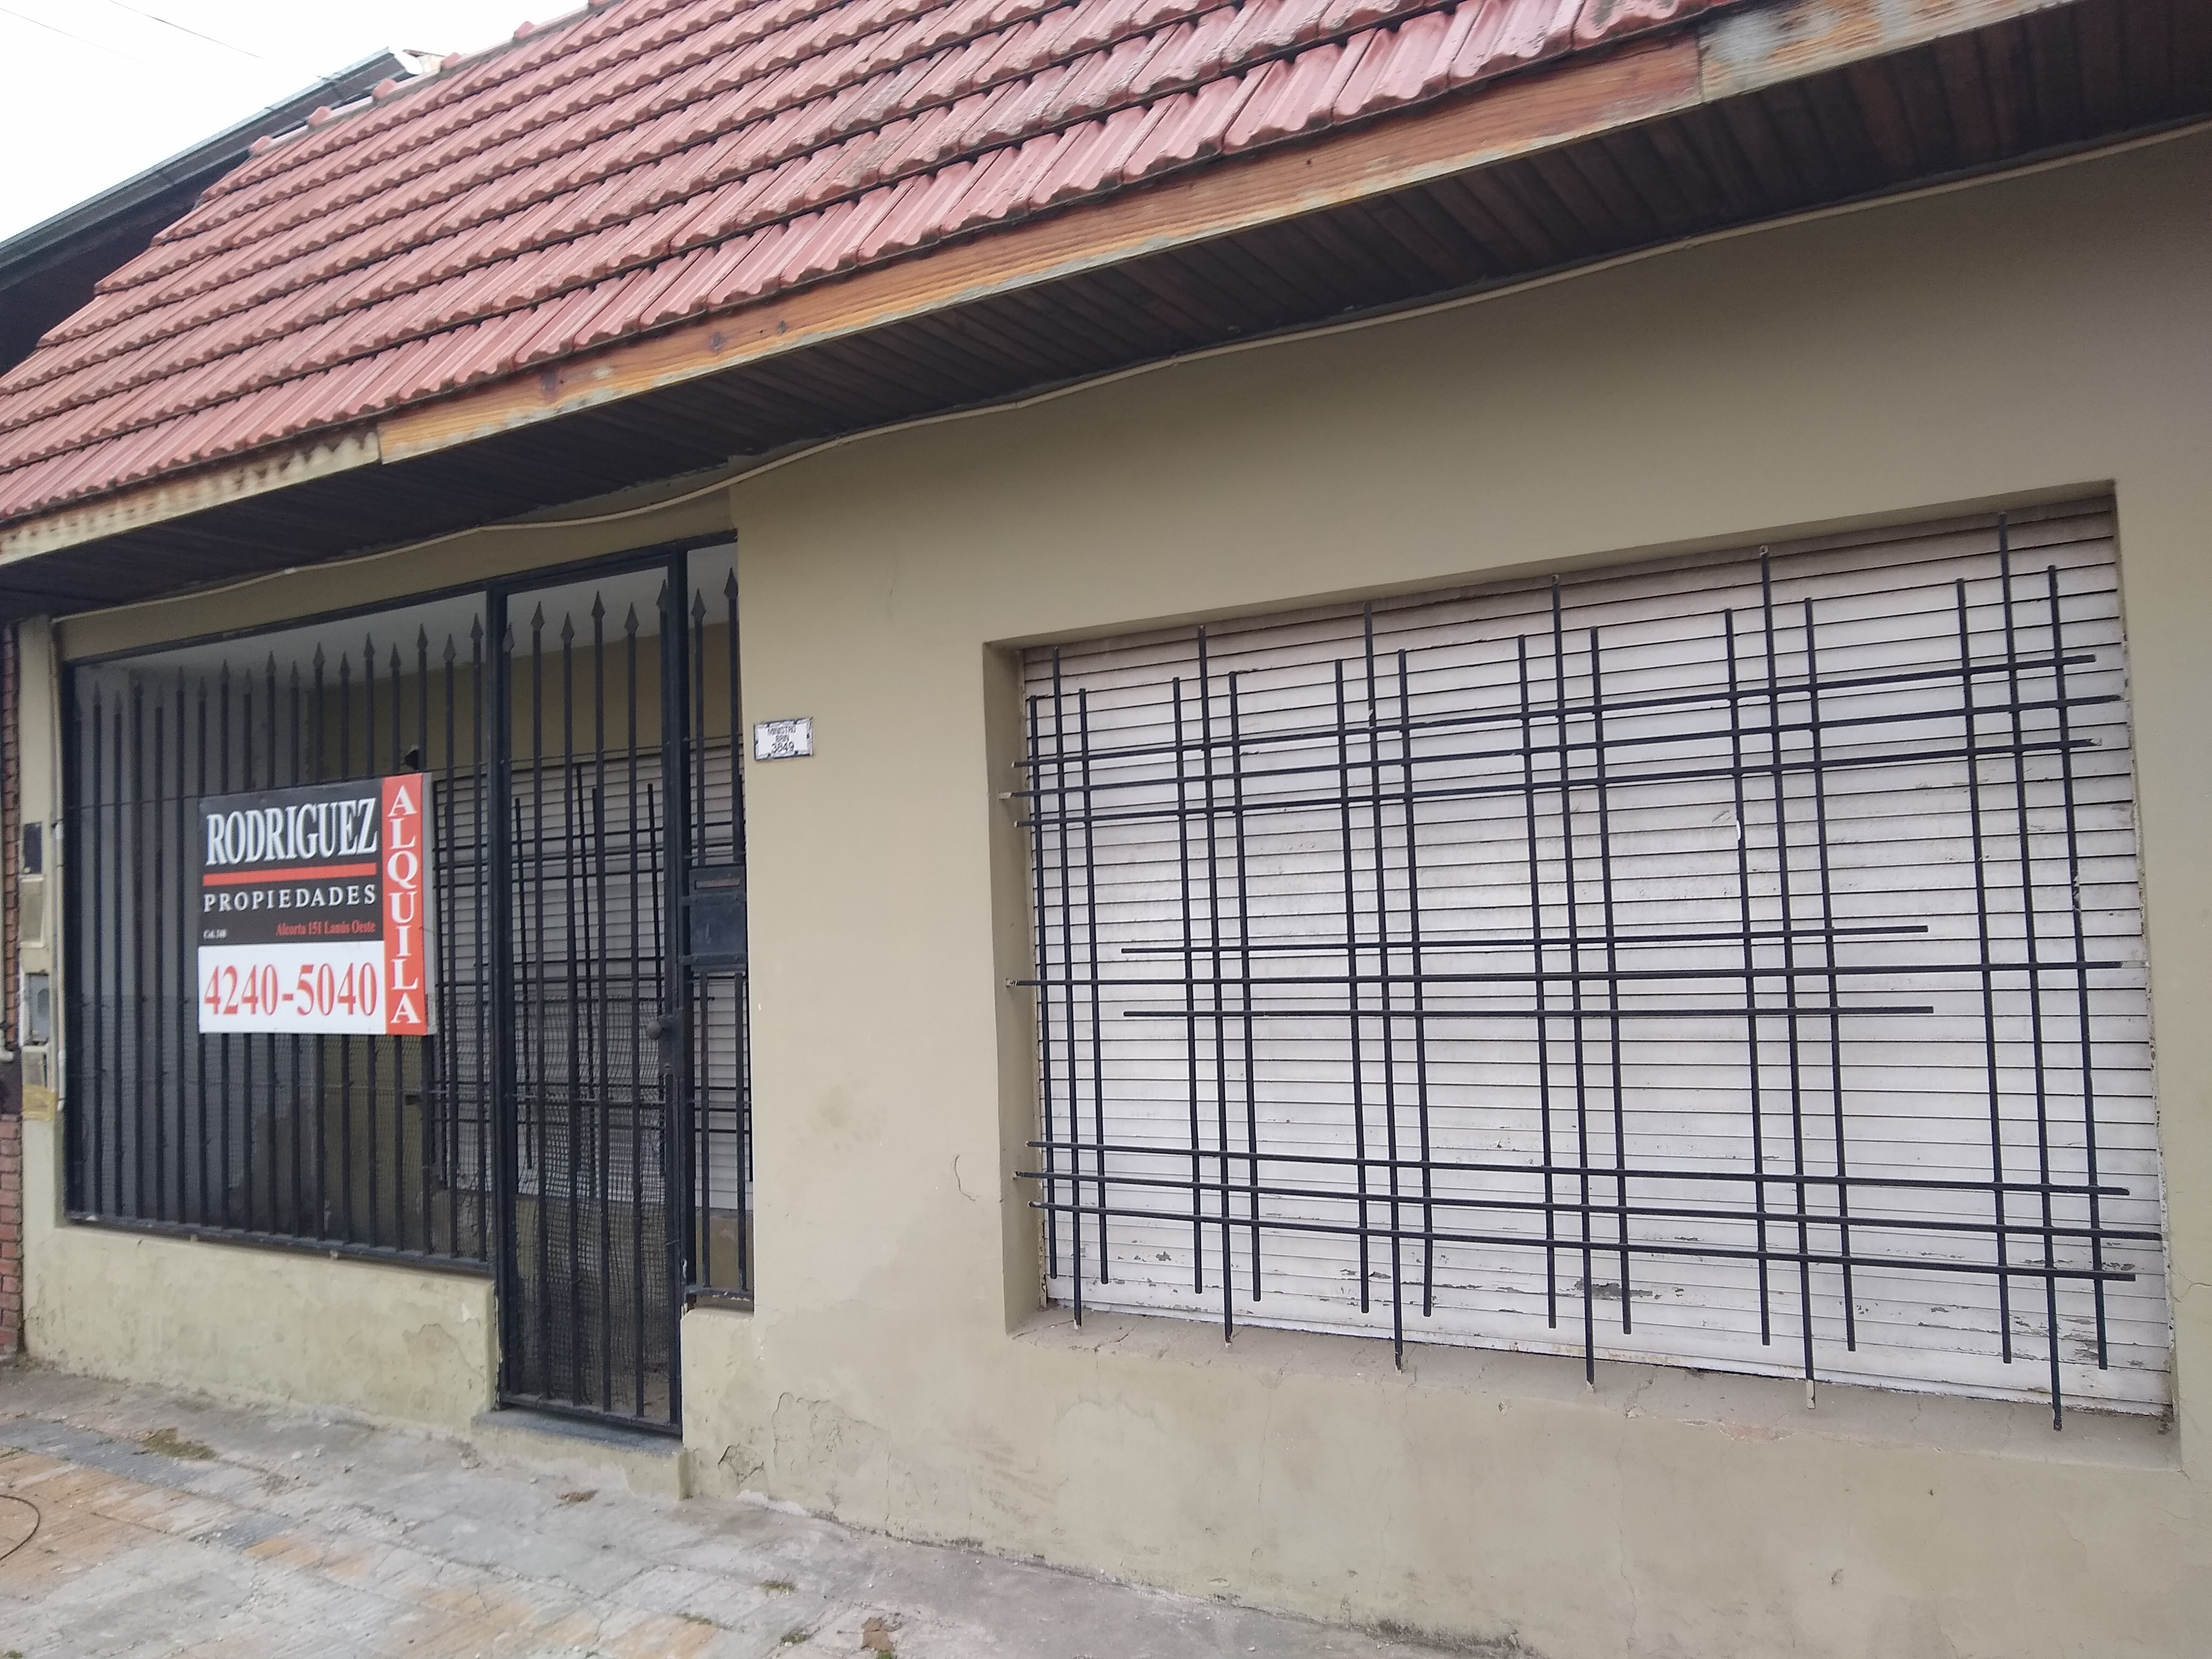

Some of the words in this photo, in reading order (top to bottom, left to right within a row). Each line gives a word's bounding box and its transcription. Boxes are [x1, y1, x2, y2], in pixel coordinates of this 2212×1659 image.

[205, 798, 377, 865] RODRIGUEZ
[203, 884, 376, 913] PROPIEDADES
[387, 785, 422, 1024] ALQUILA
[352, 919, 376, 933] Oeste
[204, 962, 377, 1016] 4240-5040
